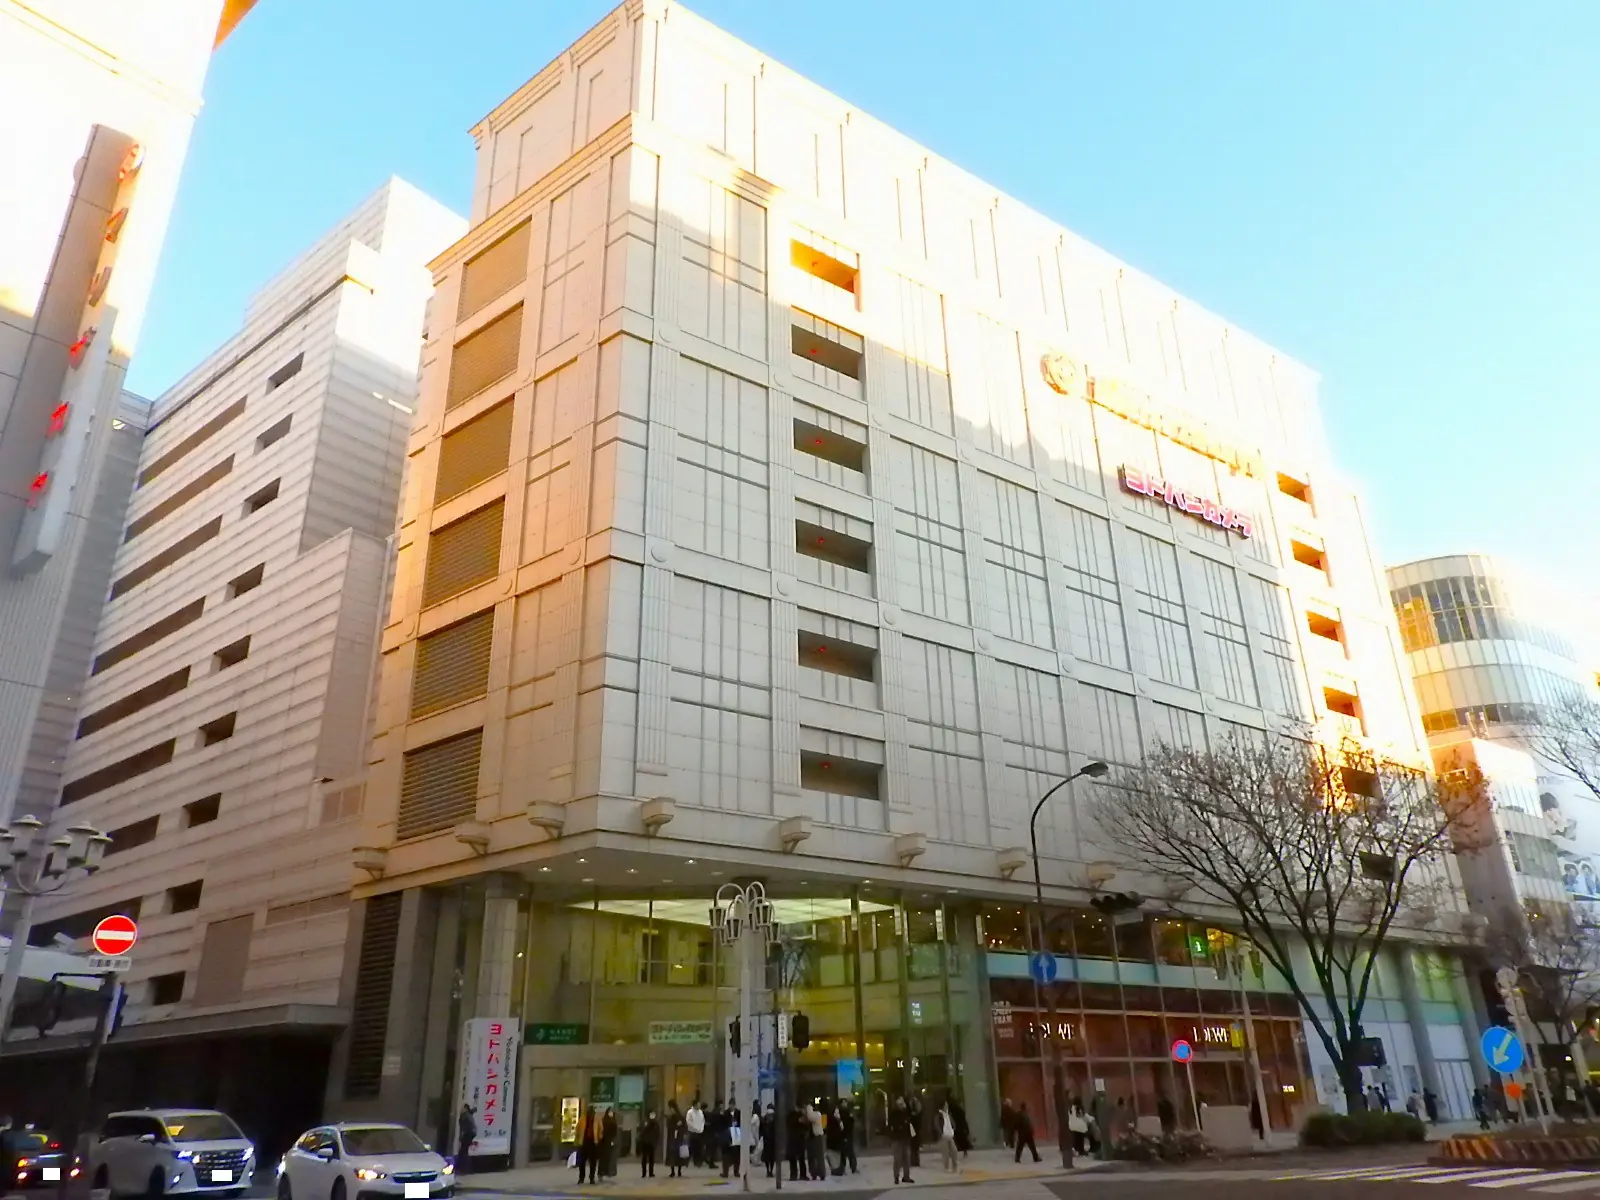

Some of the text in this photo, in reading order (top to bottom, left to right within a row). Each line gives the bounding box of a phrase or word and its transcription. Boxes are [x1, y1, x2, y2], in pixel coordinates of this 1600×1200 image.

[1121, 463, 1253, 538] ヨドバシカメラ
[484, 1023, 502, 1126] ヨドバシカメラ
